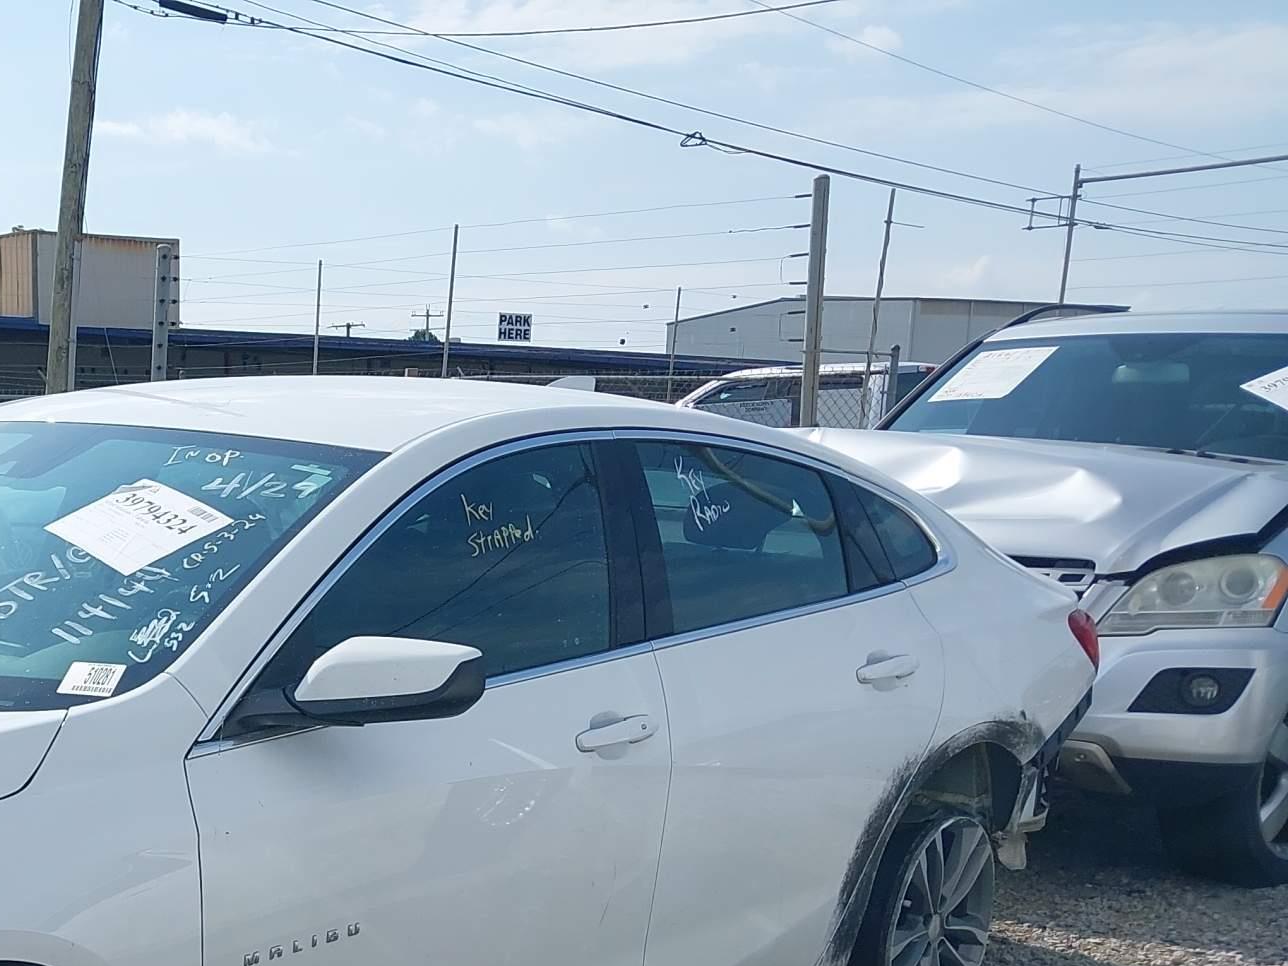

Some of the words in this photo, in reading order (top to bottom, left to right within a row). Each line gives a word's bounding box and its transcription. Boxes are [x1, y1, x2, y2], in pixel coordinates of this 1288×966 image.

[499, 314, 531, 327] PARK
[498, 328, 530, 340] HERE
[115, 493, 198, 535] 39794324
